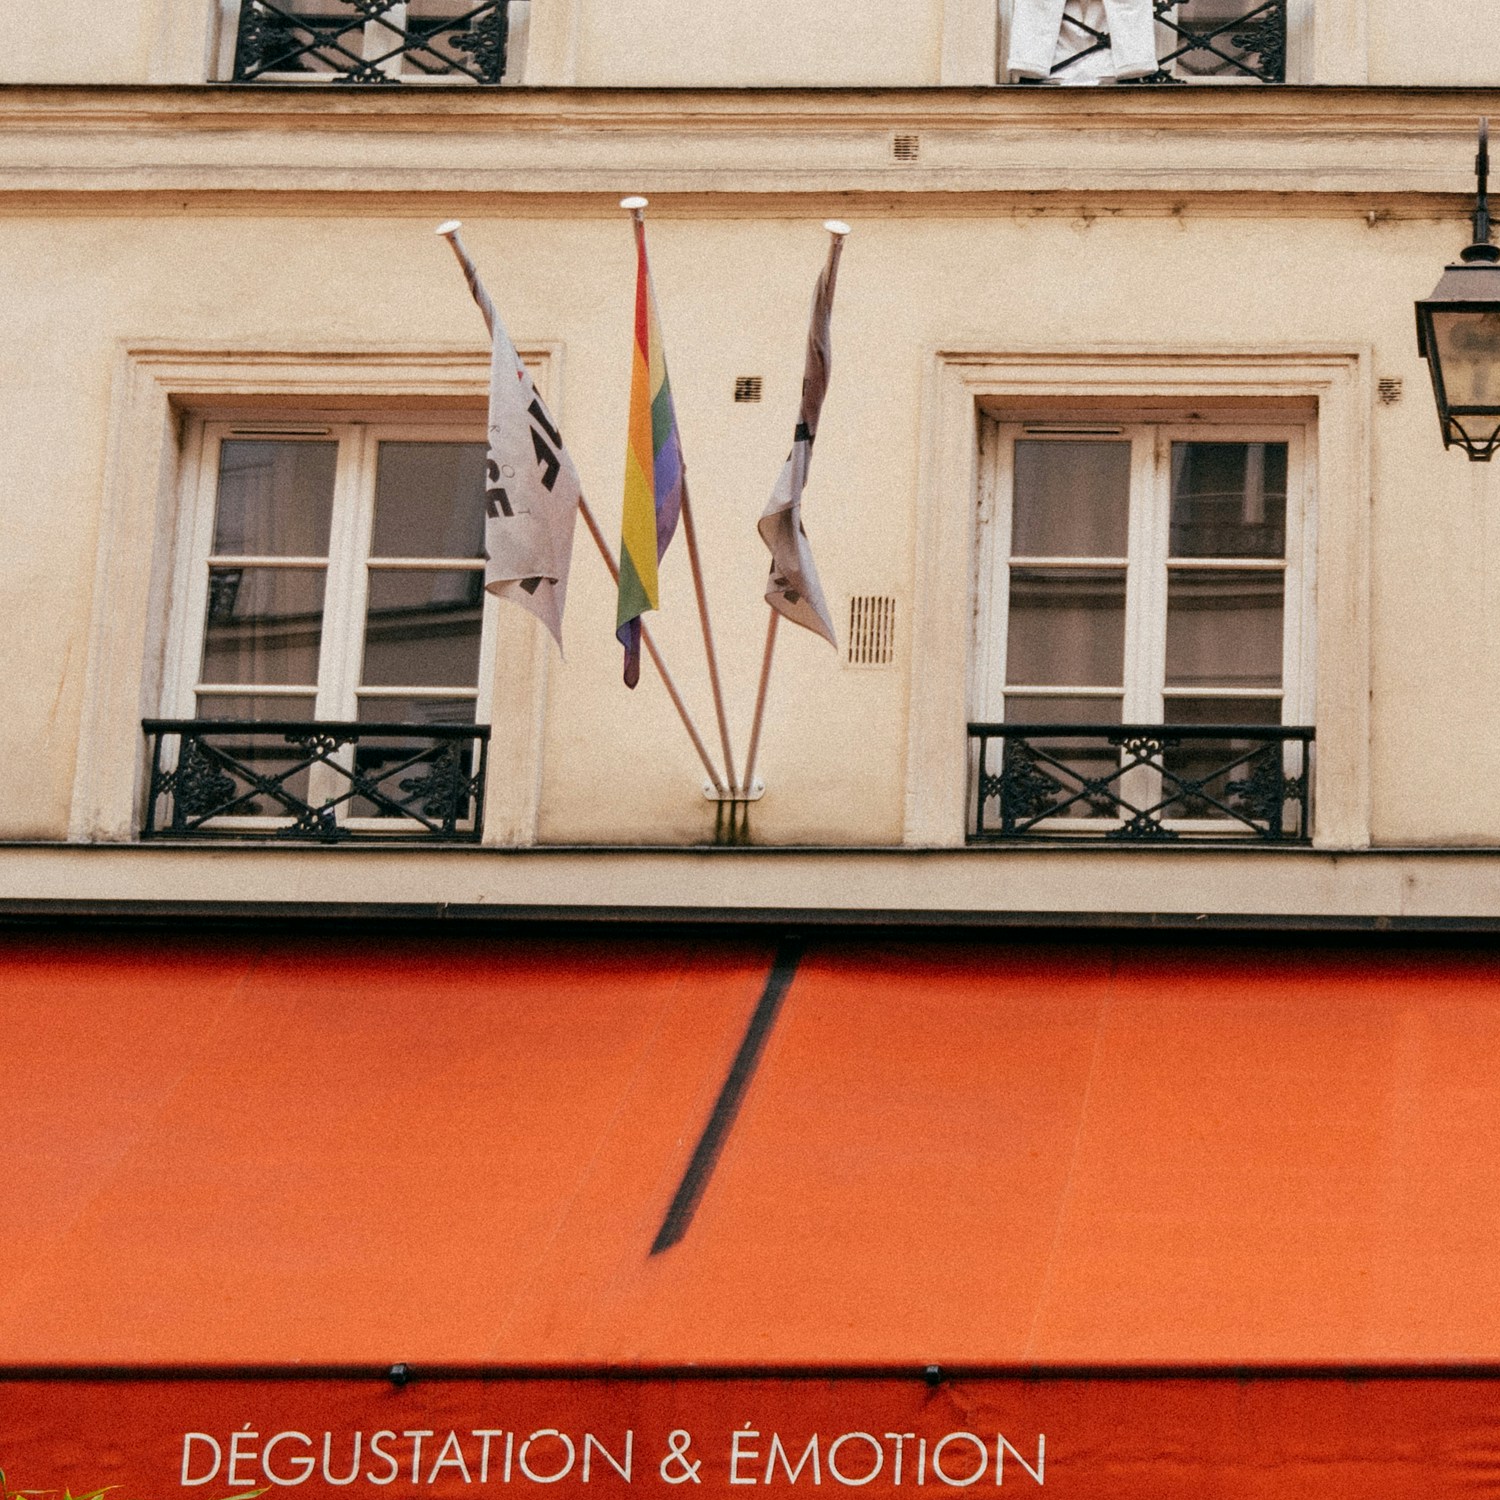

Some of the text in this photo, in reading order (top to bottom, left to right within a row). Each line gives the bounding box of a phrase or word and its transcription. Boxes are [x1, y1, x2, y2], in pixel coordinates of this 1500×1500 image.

[180, 1422, 1045, 1486] DÉGUSTATION & ÉMOTION
